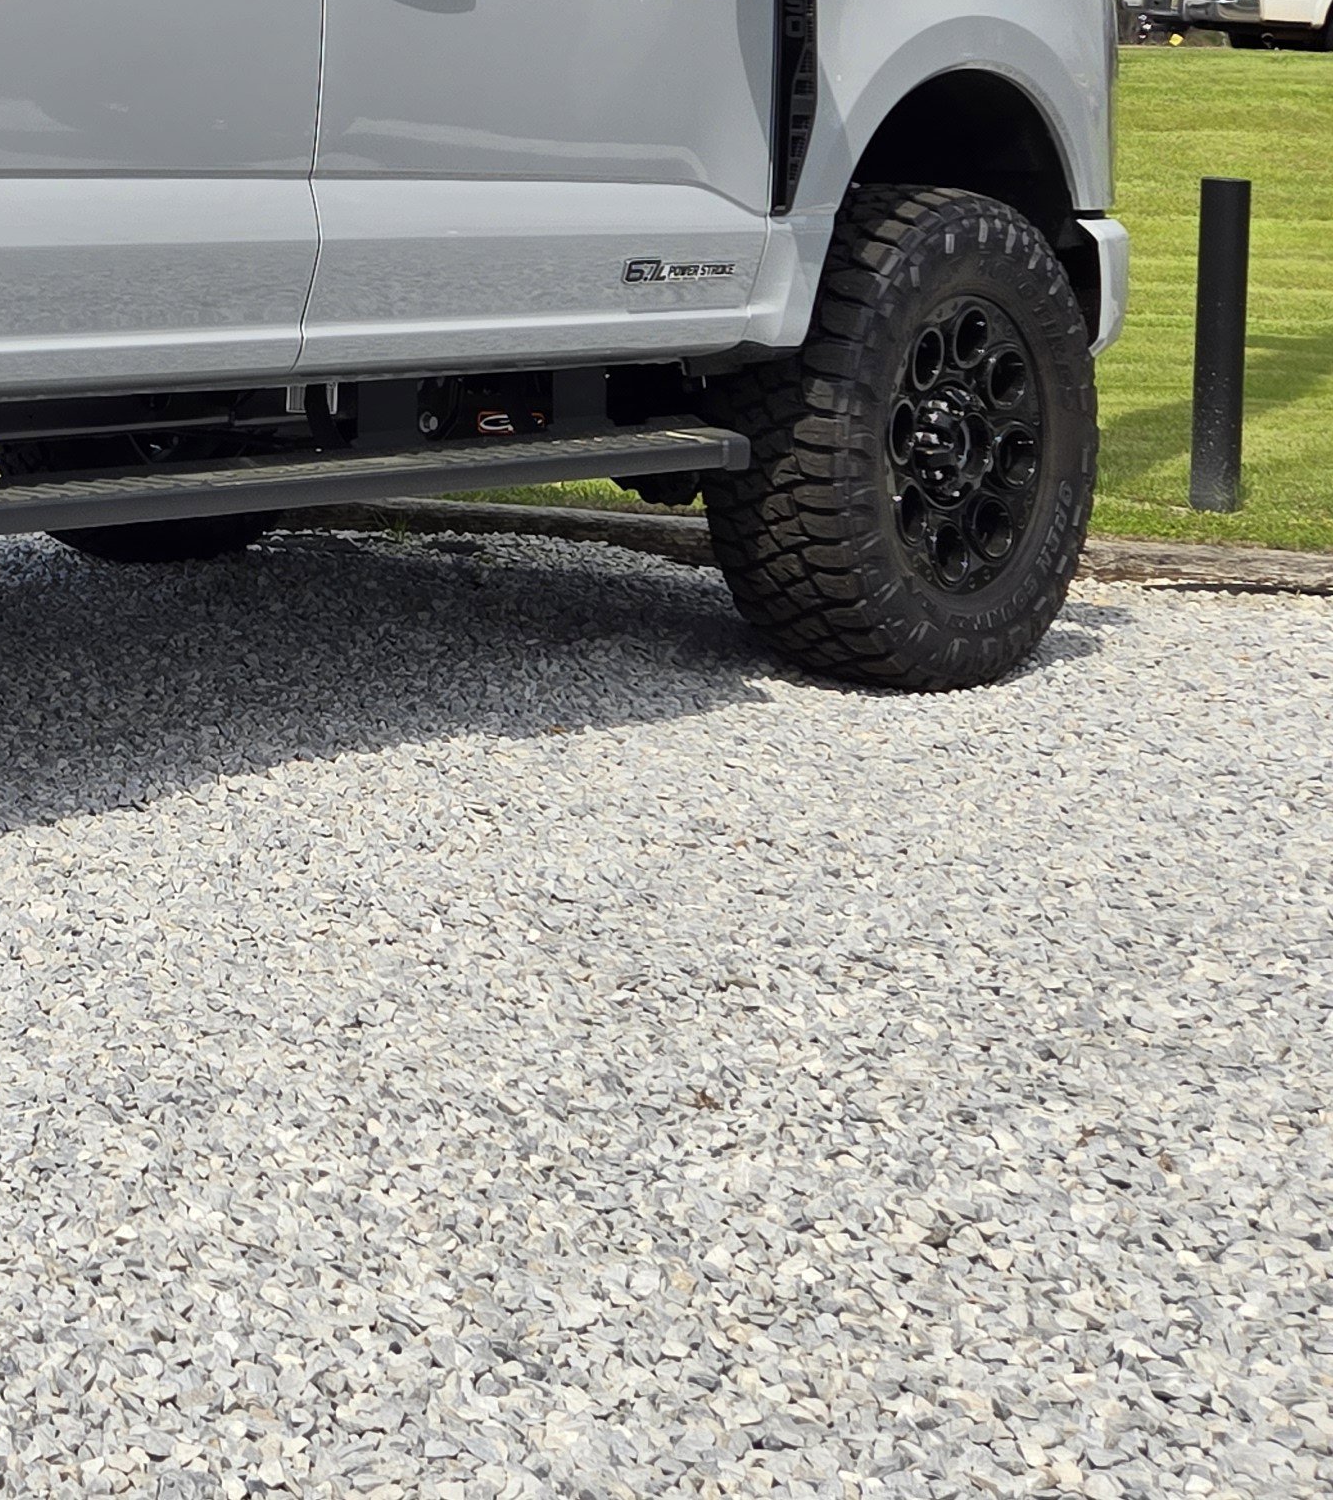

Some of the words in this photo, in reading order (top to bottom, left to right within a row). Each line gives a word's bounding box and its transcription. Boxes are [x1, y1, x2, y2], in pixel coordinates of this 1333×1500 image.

[625, 260, 667, 282] 6.7L
[668, 264, 700, 277] POWER
[700, 263, 736, 276] STROKE
